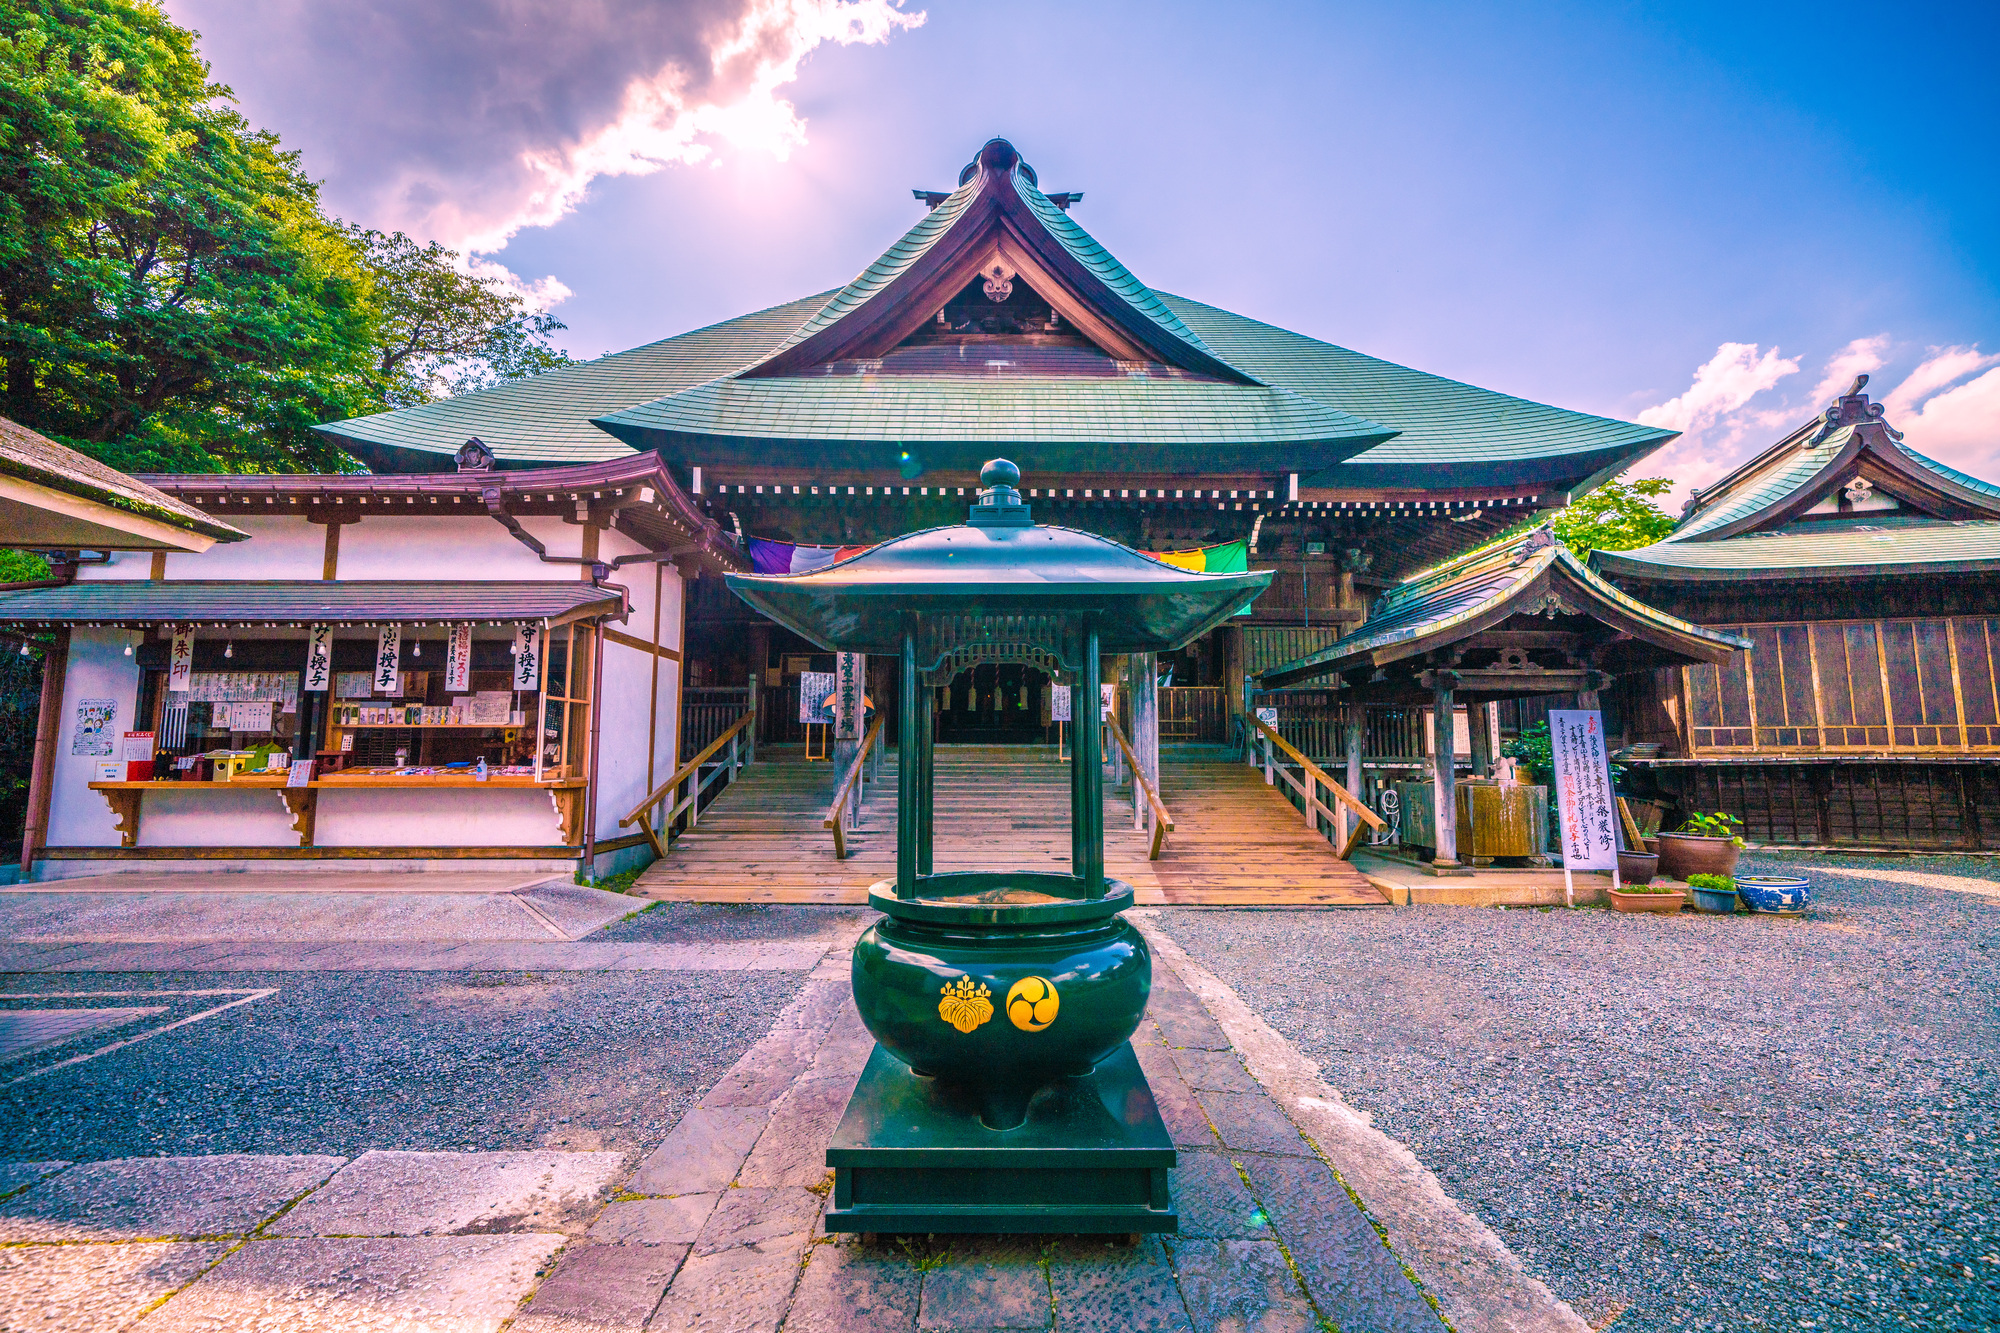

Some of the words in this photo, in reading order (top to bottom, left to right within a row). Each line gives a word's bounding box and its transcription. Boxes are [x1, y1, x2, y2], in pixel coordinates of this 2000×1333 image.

[173, 623, 193, 680] 御朱印
[377, 621, 397, 687] ふだ授与
[518, 621, 536, 685] 守り授与
